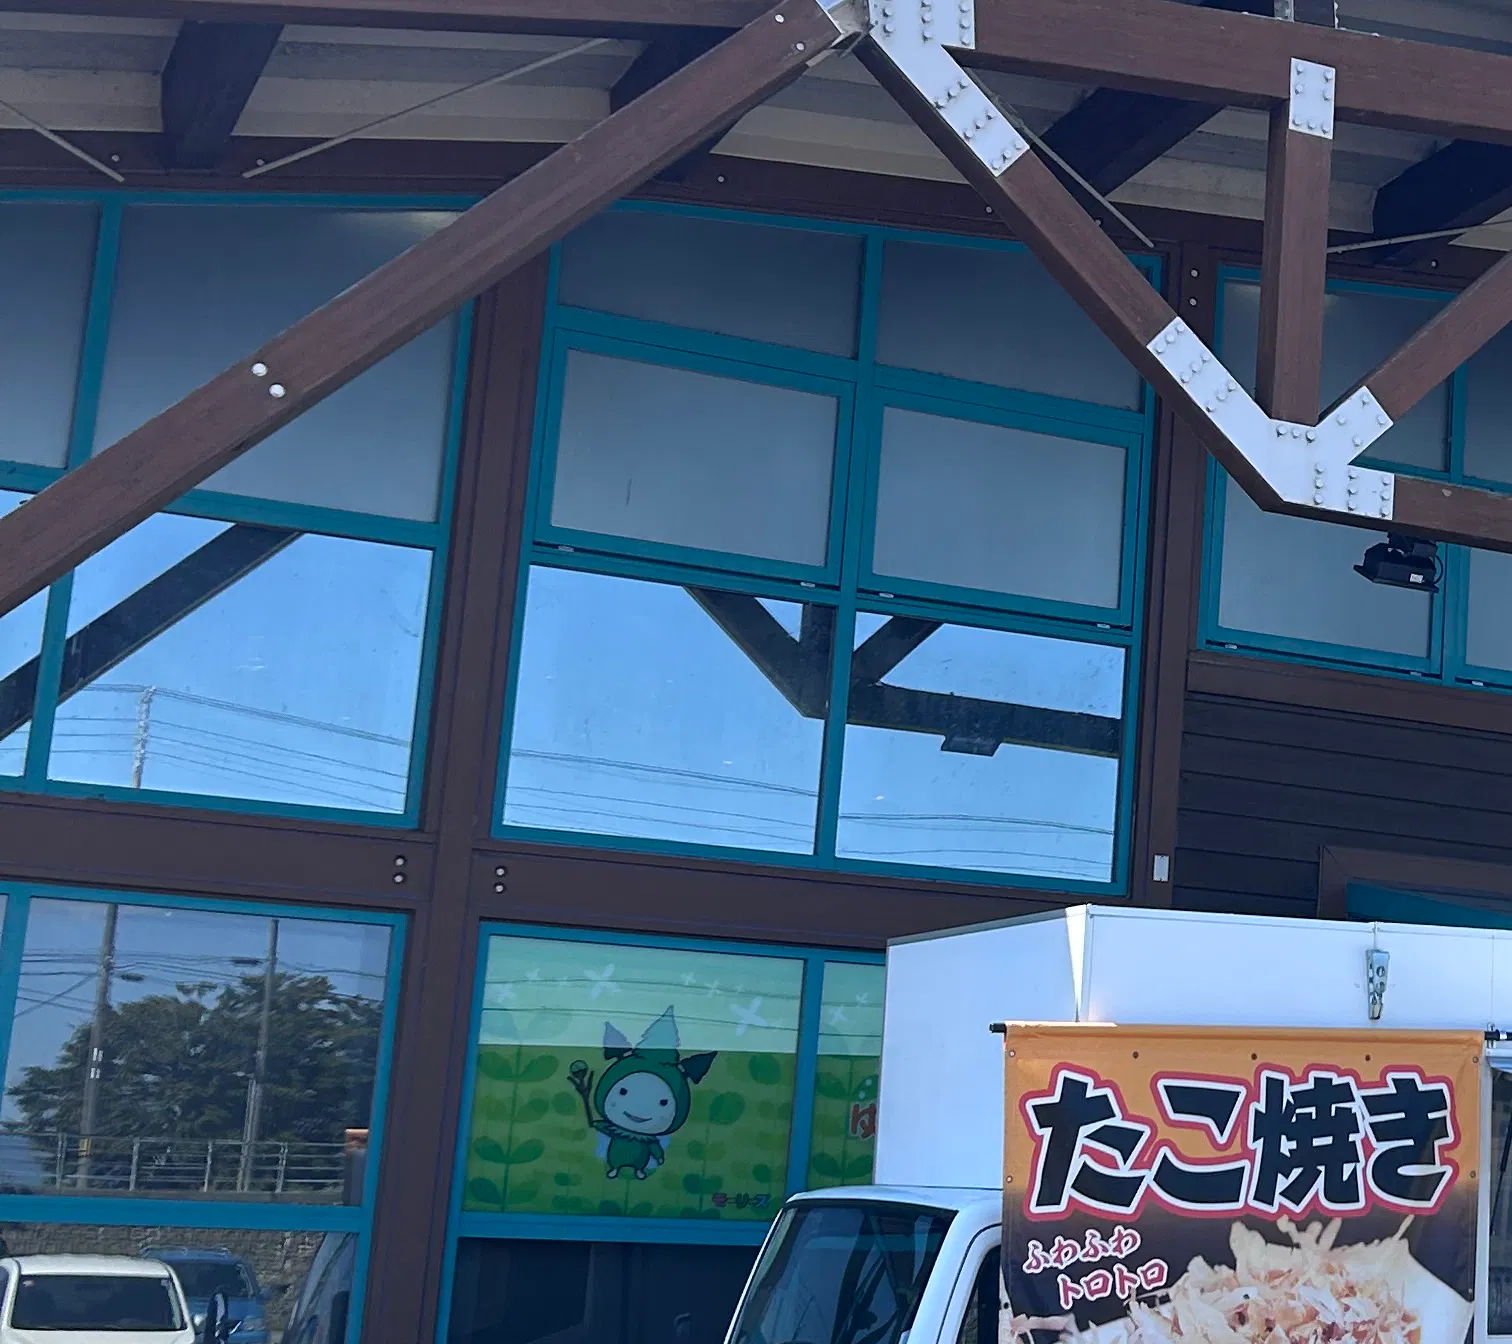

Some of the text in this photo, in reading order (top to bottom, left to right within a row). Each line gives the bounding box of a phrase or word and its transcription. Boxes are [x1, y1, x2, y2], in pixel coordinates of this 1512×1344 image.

[1026, 1069, 1454, 1214] たこ焼き
[1023, 1225, 1141, 1274] ふわふわ
[1057, 1258, 1168, 1310] トロトロ
